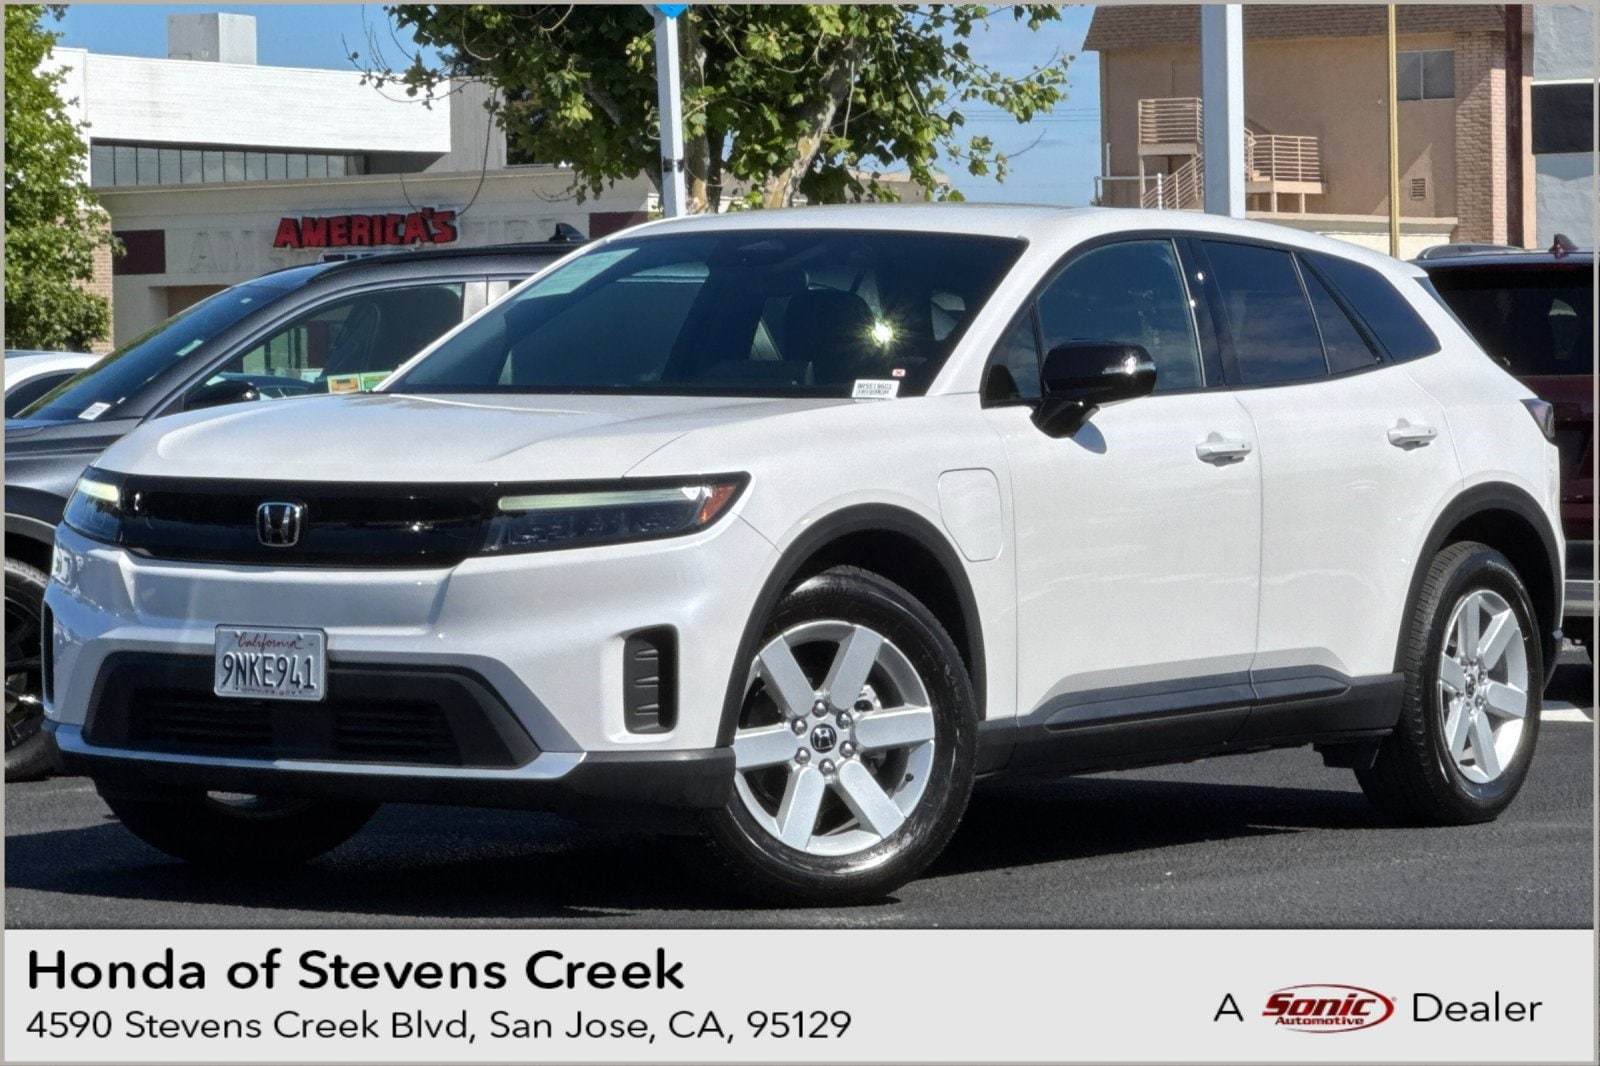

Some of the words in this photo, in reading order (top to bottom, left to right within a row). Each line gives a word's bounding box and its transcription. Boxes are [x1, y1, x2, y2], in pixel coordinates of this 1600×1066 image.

[274, 207, 457, 249] AMERICA'S
[238, 632, 304, 651] California
[221, 653, 317, 689] 9NKE941
